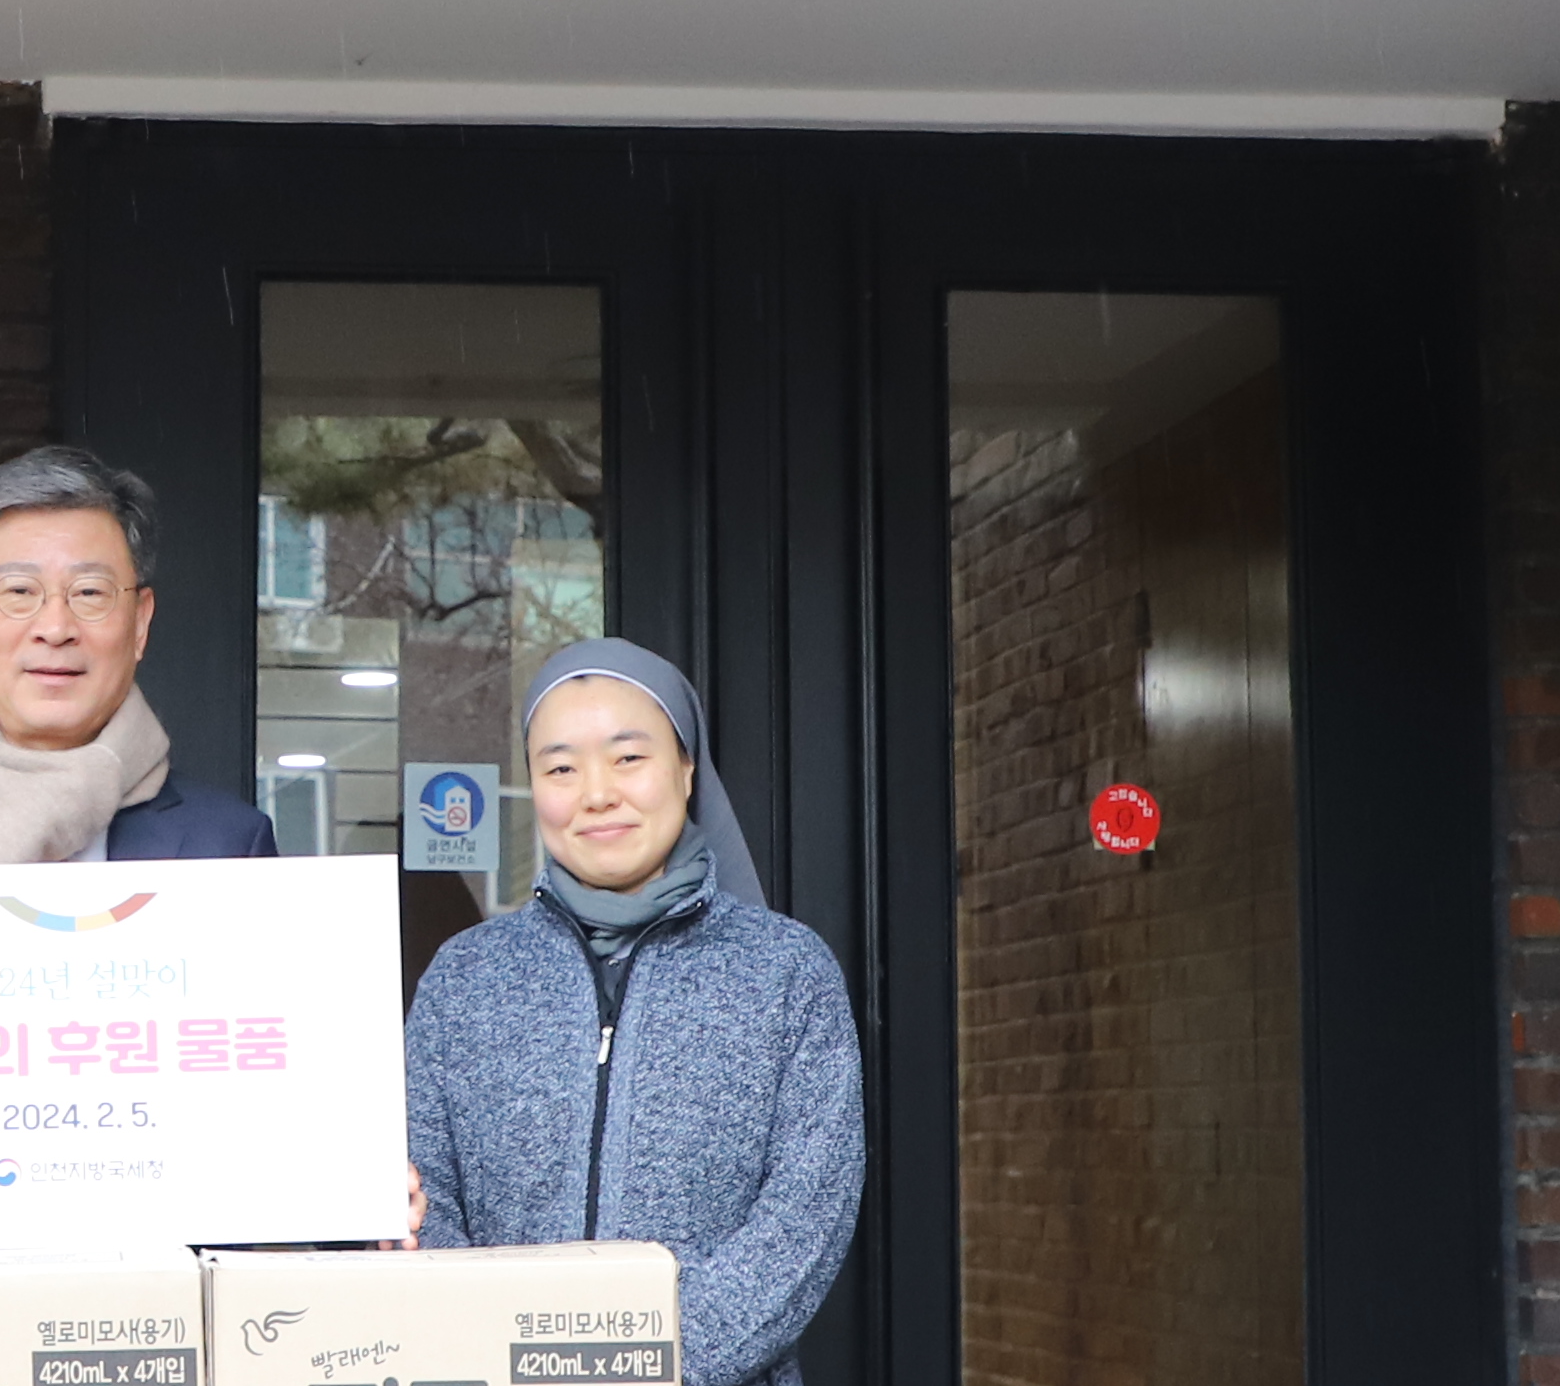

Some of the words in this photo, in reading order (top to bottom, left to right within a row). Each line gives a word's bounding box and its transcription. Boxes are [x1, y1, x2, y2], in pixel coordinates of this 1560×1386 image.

[86, 959, 189, 1001] 설맞이
[48, 1020, 159, 1075] 후원
[177, 1016, 288, 1071] 물품
[2, 1104, 88, 1131] 2024.
[97, 1102, 123, 1128] 2.
[132, 1101, 156, 1128] 5.
[30, 1159, 164, 1183] 인천지방국세청
[37, 1318, 186, 1346] 옐로미모사(용기)
[514, 1310, 662, 1338] 옐로미모사(용기)
[39, 1360, 111, 1385] 4210mL
[117, 1366, 128, 1383] x
[134, 1356, 185, 1383] 4개입
[517, 1353, 589, 1376] 4210mL
[594, 1359, 606, 1375] x
[611, 1350, 662, 1378] 4개입
